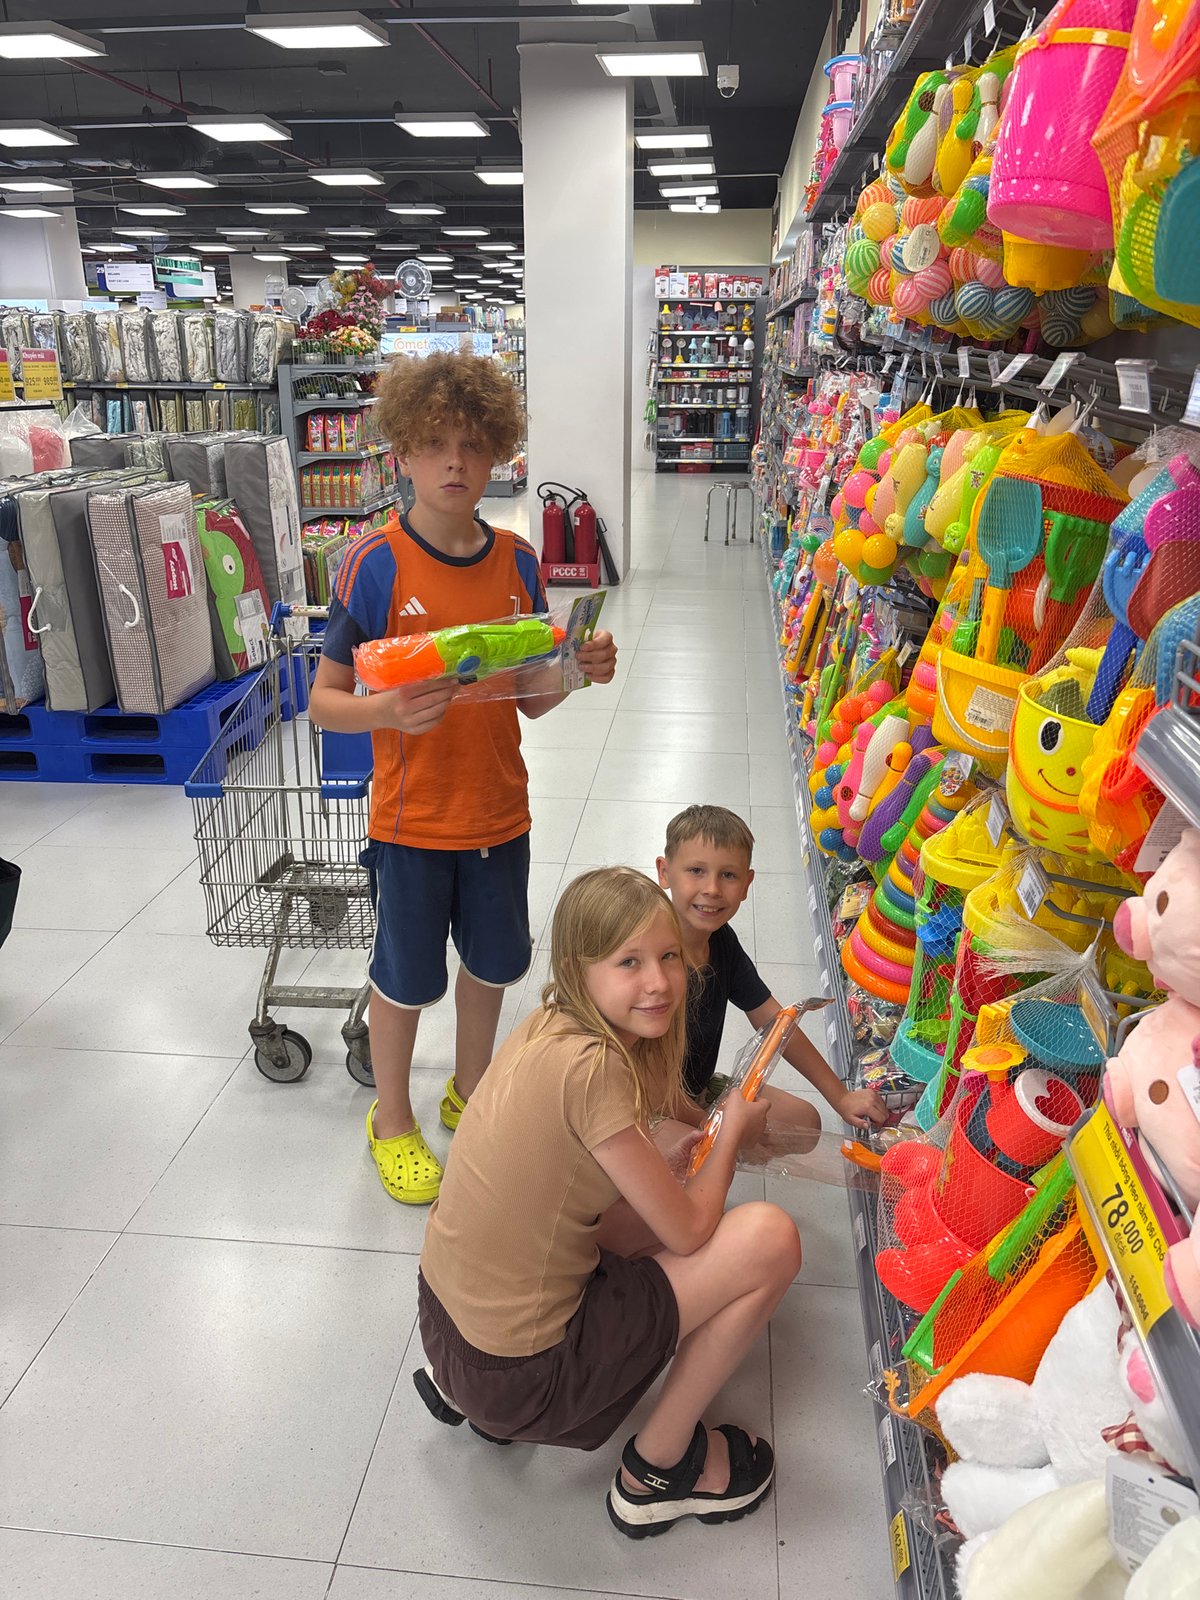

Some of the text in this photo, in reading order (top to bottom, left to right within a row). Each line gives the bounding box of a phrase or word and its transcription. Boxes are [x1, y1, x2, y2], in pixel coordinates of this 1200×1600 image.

[96, 266, 105, 274] 29
[552, 567, 577, 577] PCCC
[1103, 1121, 1113, 1141] Thú
[1110, 1140, 1122, 1160] nhồi
[1119, 1159, 1131, 1185] bông
[1129, 1181, 1139, 1202] Heo
[1153, 1238, 1165, 1262] Chó
